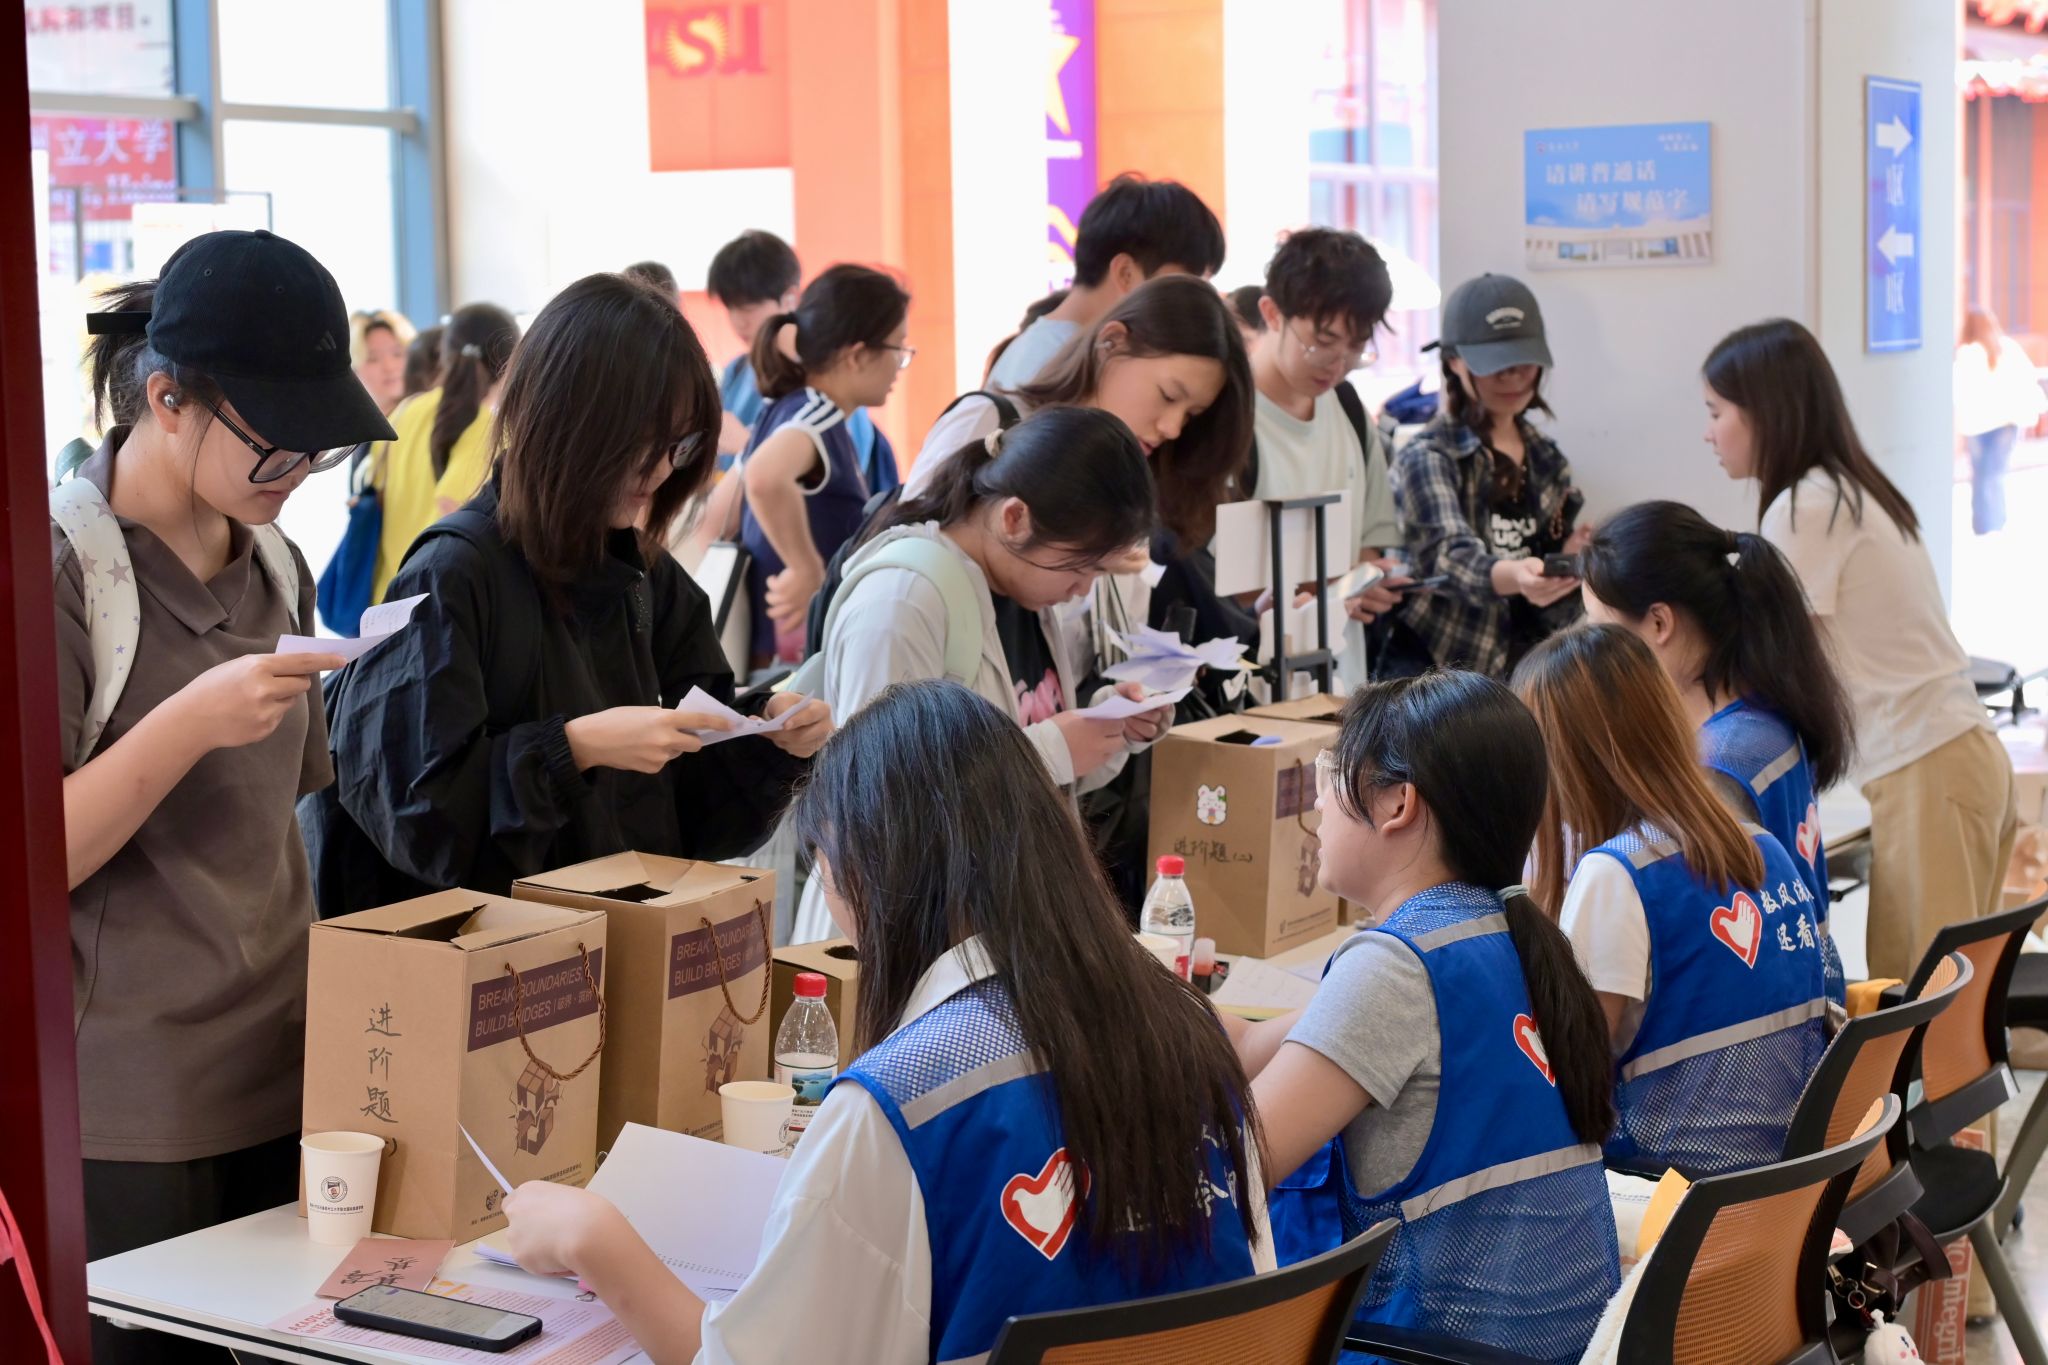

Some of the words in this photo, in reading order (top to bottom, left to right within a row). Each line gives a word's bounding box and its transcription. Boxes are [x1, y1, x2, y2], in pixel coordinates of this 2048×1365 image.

[676, 937, 711, 961] BREAK
[674, 963, 704, 987] BUILD
[704, 951, 742, 978] BRDGES
[478, 985, 515, 1011] BREAK
[475, 1013, 508, 1038] BUILD
[360, 1002, 402, 1124] 进阶题
